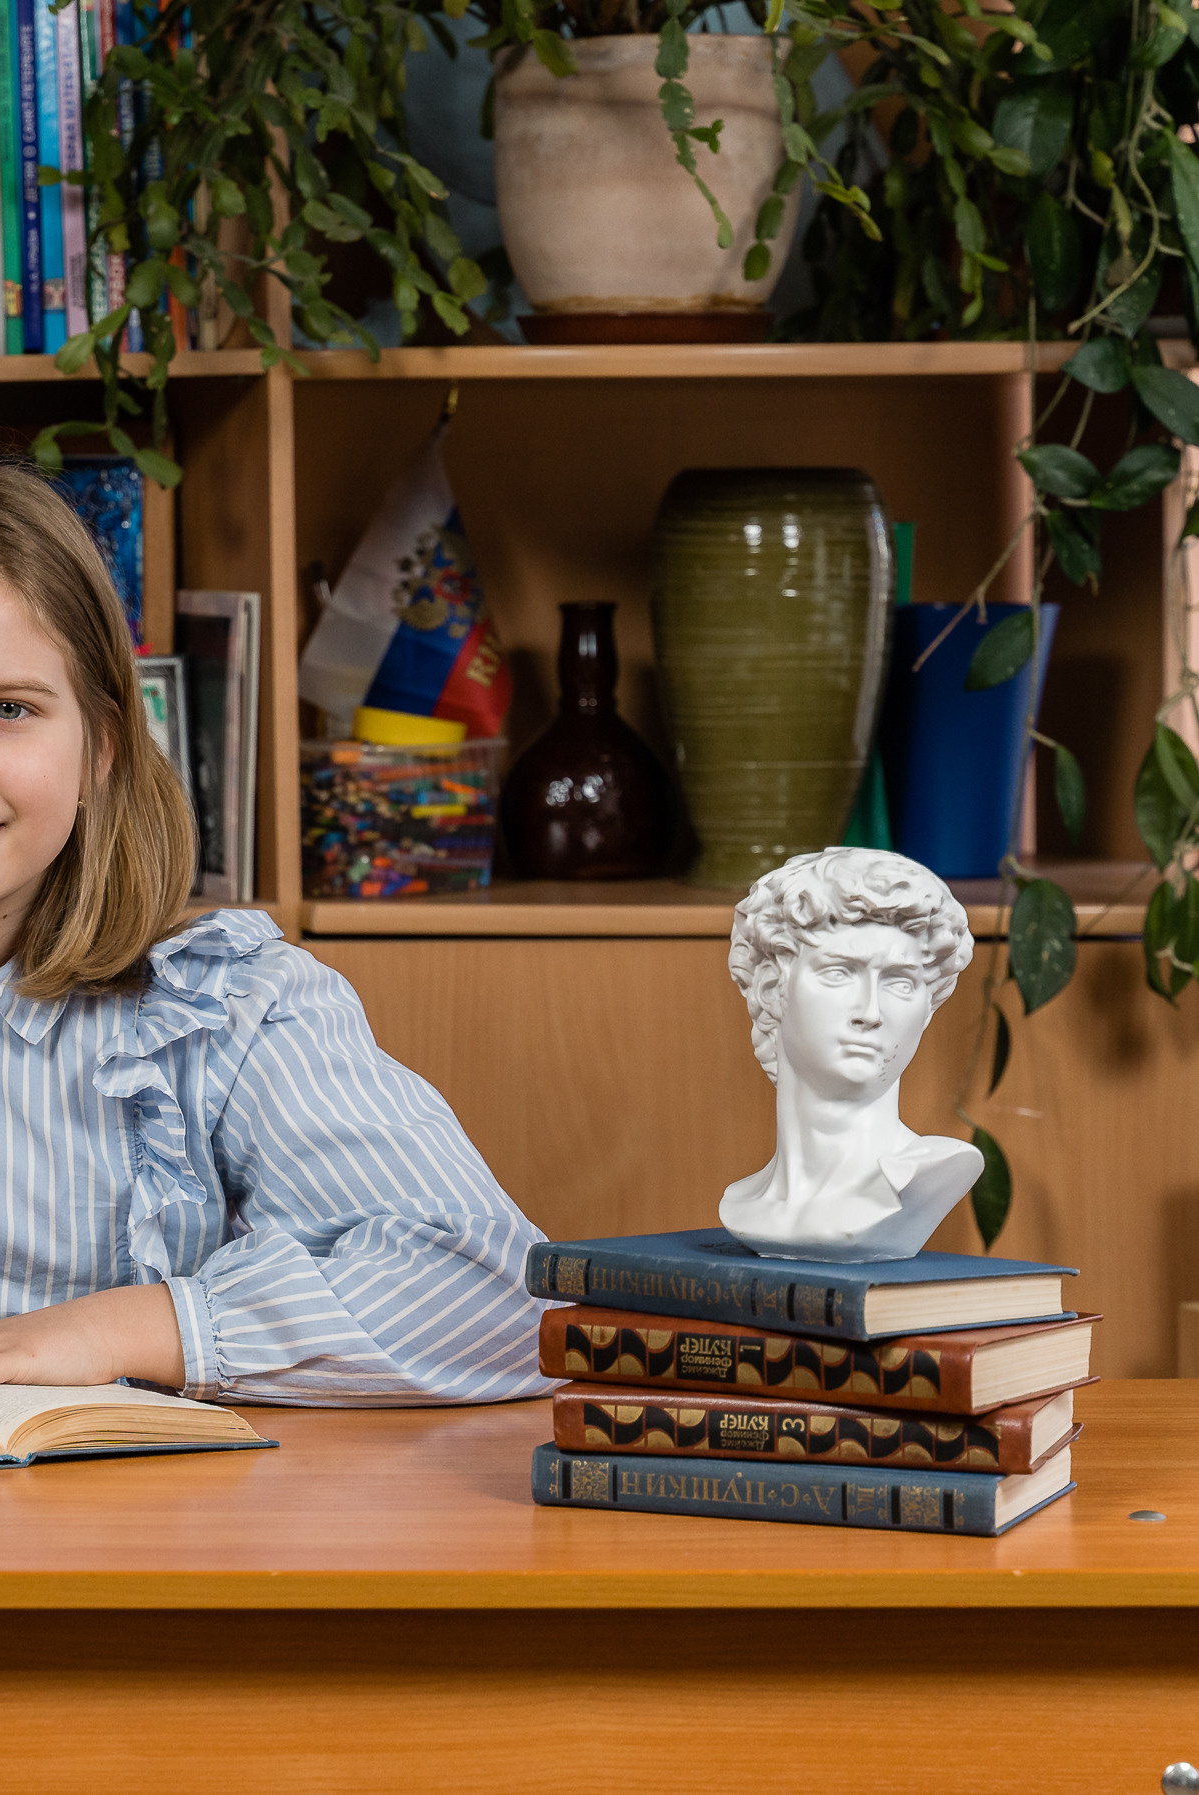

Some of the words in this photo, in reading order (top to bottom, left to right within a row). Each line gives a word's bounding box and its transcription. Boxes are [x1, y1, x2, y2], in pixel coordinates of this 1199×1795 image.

[679, 1337, 732, 1356] КУПЕР
[680, 1354, 733, 1368] Фенимор
[681, 1365, 728, 1379] Джеймс
[718, 1413, 770, 1431] КУПЕР
[782, 1417, 805, 1432] 3
[719, 1429, 770, 1442] Фенимор
[720, 1438, 765, 1451] Джеймс
